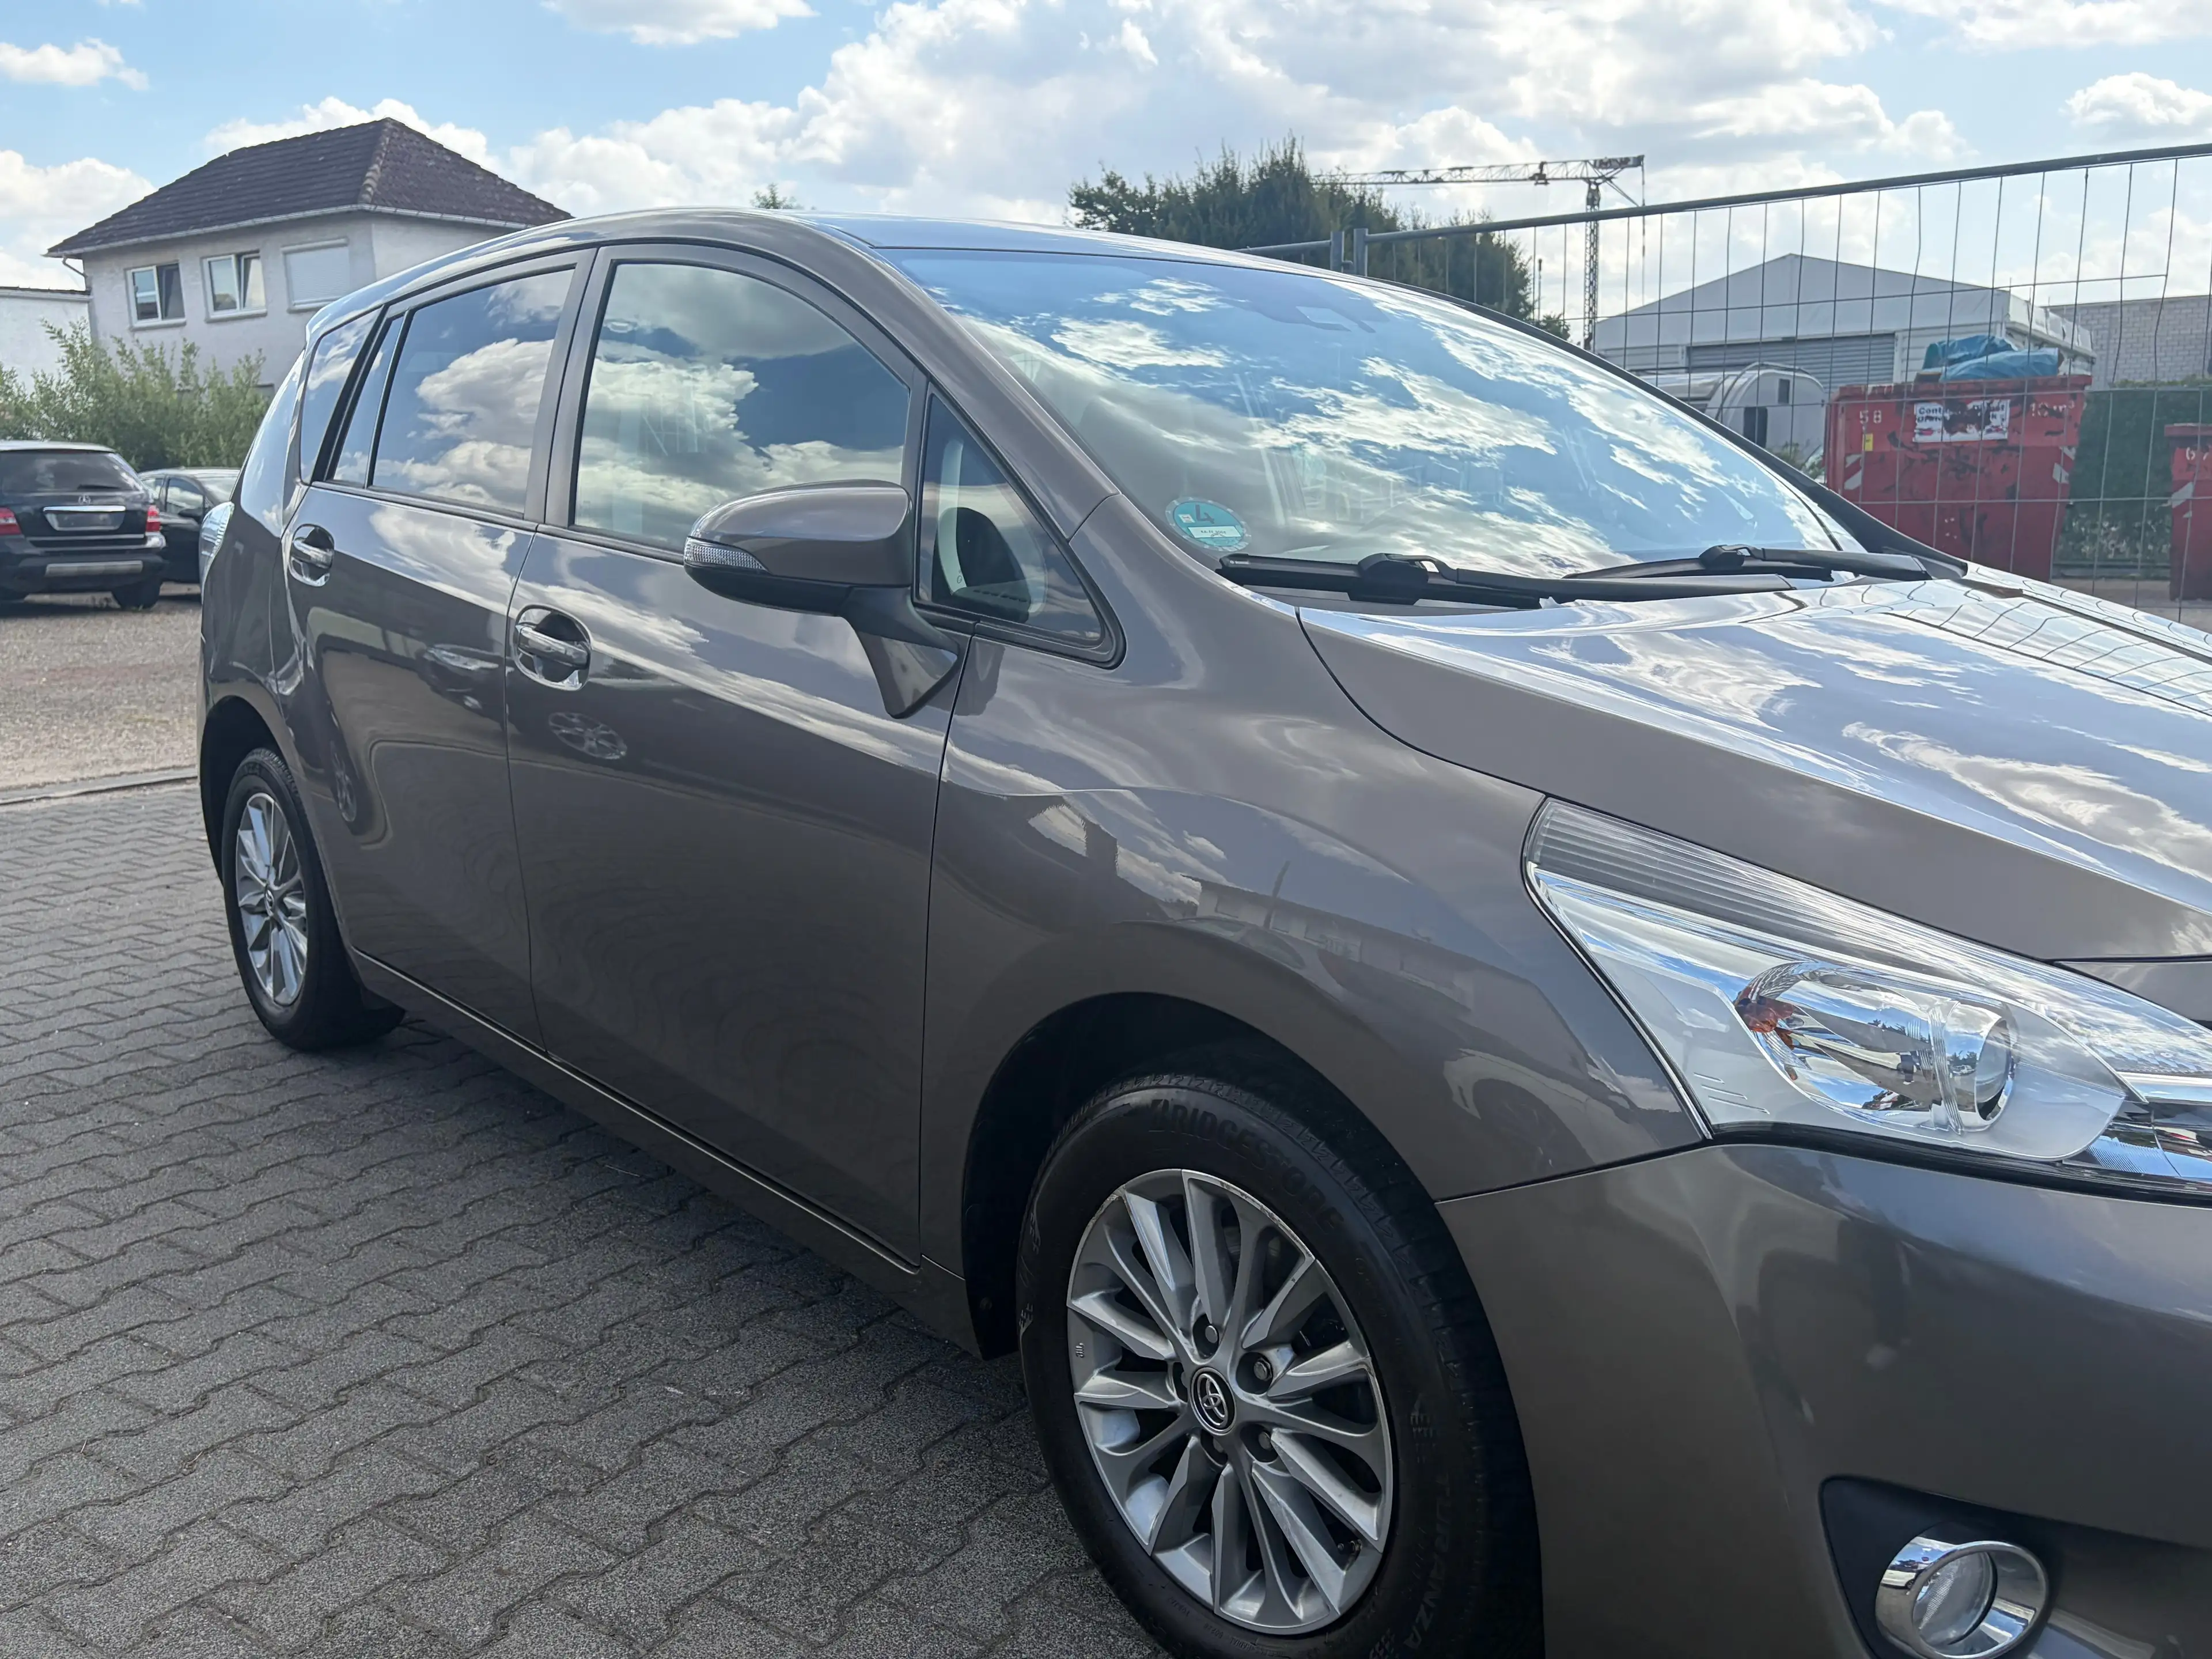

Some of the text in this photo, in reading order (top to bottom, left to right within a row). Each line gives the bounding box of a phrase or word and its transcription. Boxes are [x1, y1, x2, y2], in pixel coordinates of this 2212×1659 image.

[1859, 410, 1882, 424] 58
[1195, 504, 1215, 524] 4
[1147, 1098, 1344, 1234] BRIDGESTONE
